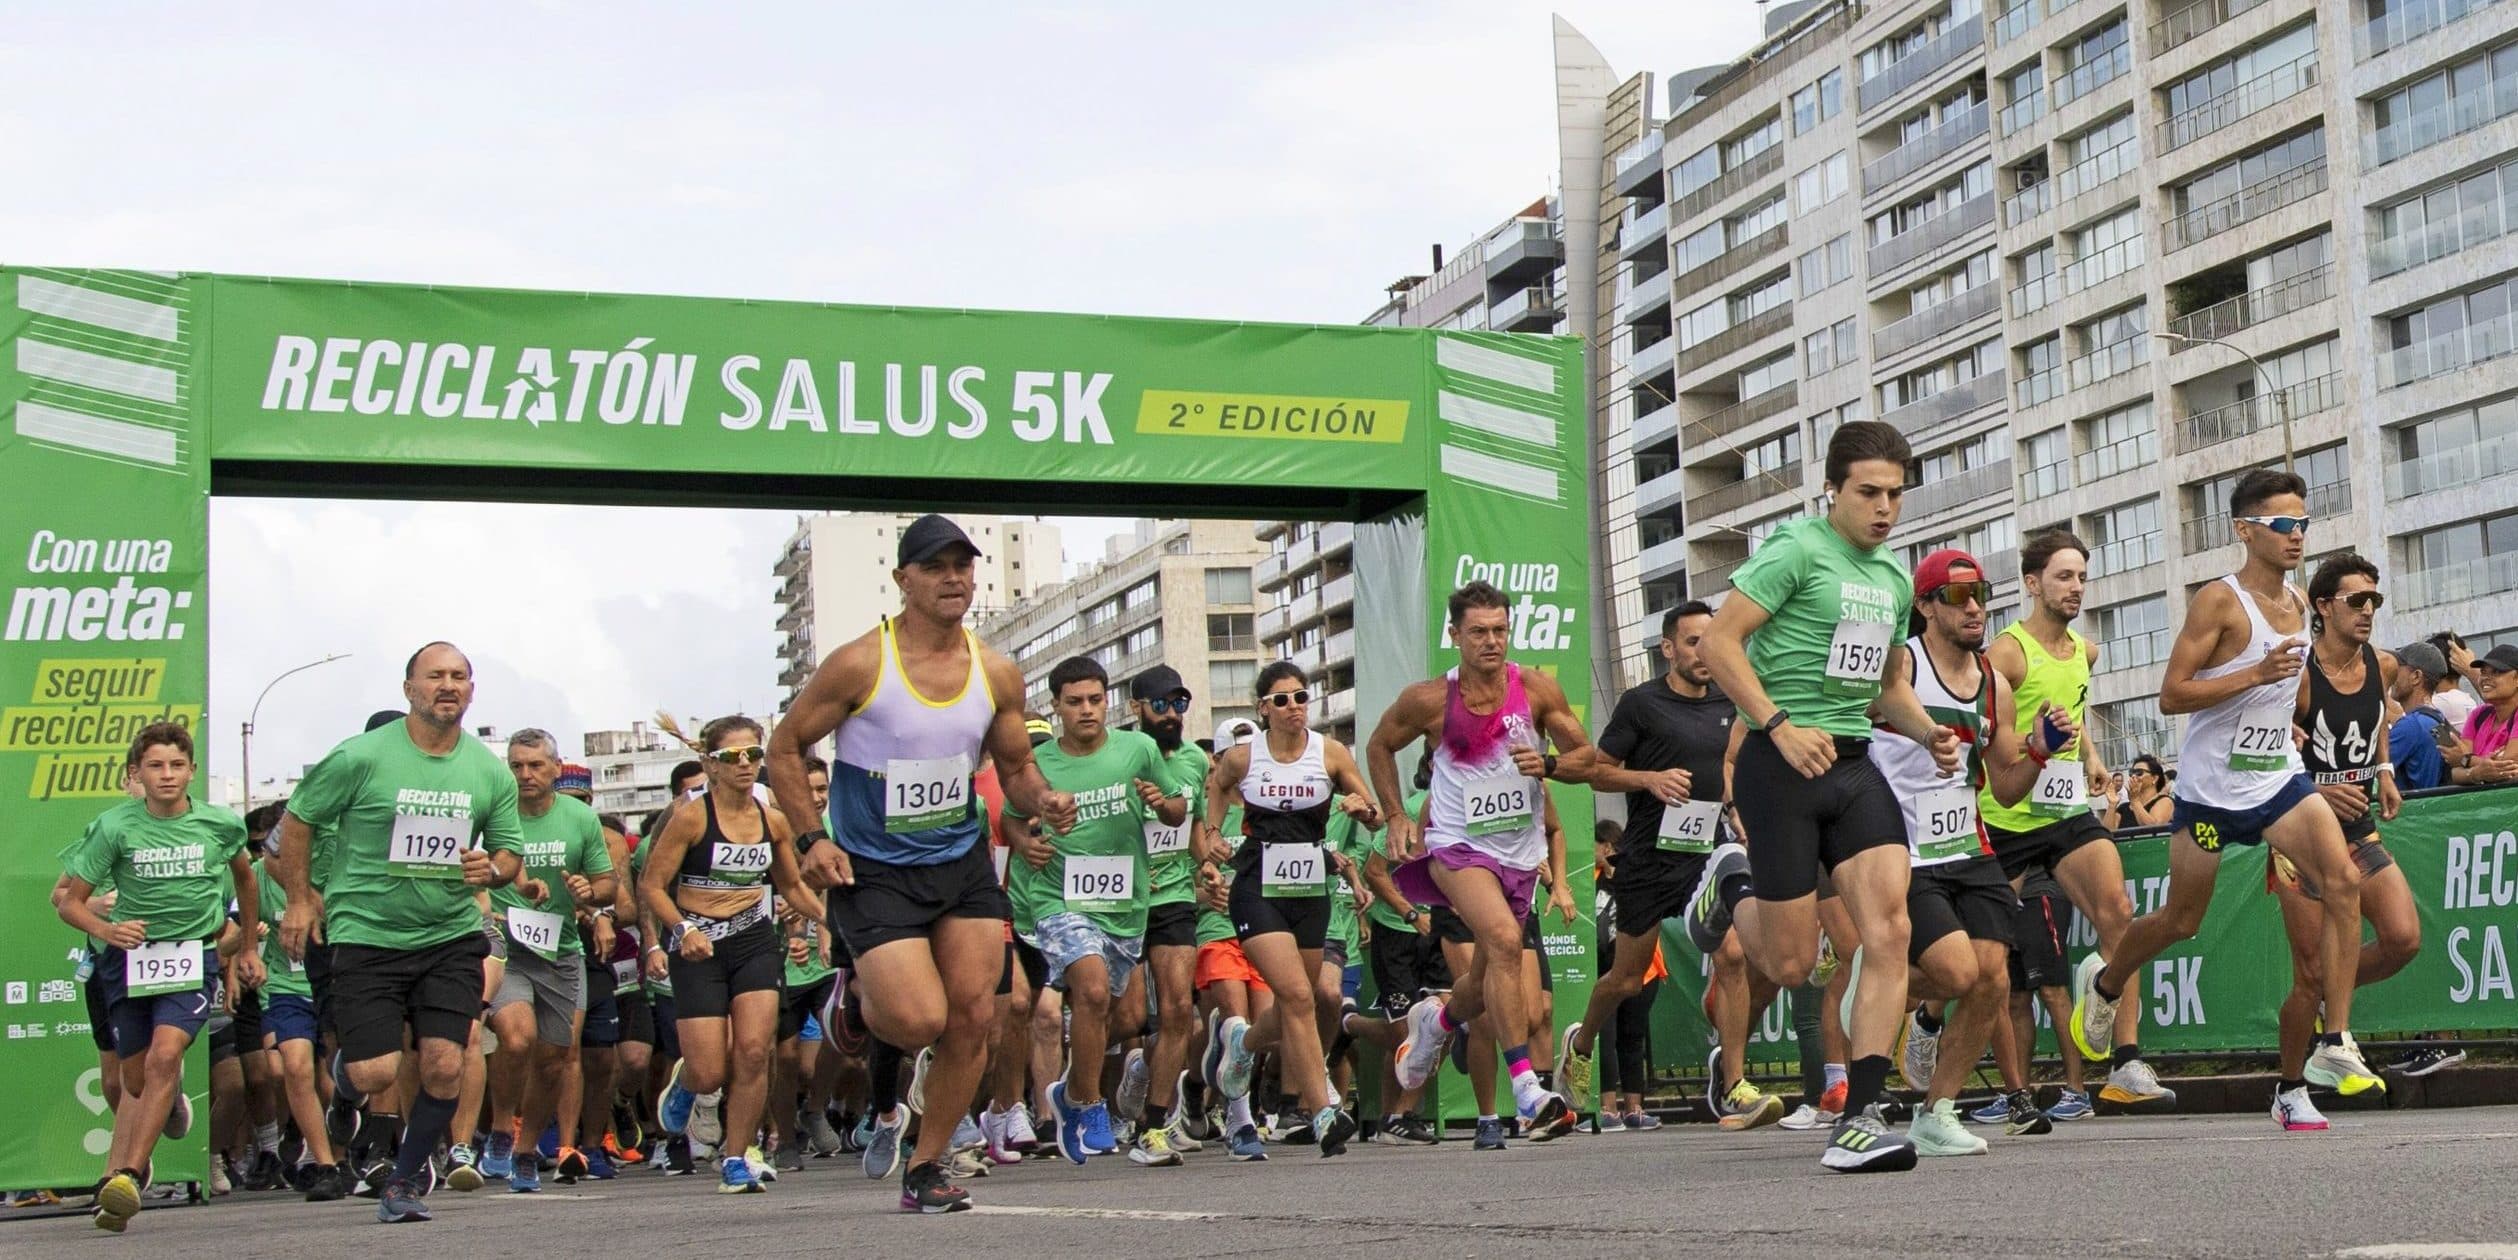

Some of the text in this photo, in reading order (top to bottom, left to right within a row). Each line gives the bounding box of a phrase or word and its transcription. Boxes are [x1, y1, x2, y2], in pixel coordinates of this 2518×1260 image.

[262, 335, 1114, 444] RECICLATÓN SALUS 5K
[1219, 402, 1376, 435] EDICIÓN
[27, 530, 173, 573] Con una
[1509, 562, 1559, 592] una
[5, 576, 193, 641] meta:
[1840, 601, 1881, 623] SALUS
[1839, 643, 1882, 673] 1593
[45, 659, 155, 705] seguir
[2239, 726, 2286, 751] 2720
[396, 788, 472, 809] RECICLATÓN
[897, 777, 960, 809] 1304
[1074, 782, 1127, 806] CICLATÓN
[1260, 785, 1314, 797] LEGION
[2044, 777, 2074, 800] 628
[1076, 804, 1109, 823] ALUS
[1111, 799, 1129, 815] 5K
[1471, 790, 1525, 817] 2603
[1679, 816, 1704, 836] 45
[1931, 806, 1968, 836] 507
[405, 834, 456, 858] 1199
[1153, 829, 1178, 849] 741
[133, 842, 206, 864] RECICLATÓN
[550, 854, 567, 866] 5K
[719, 846, 768, 867] 2496
[134, 860, 206, 878] SALUS 5K
[1275, 860, 1314, 880] 407
[2444, 831, 2518, 909] REC
[1072, 873, 1124, 894] 1098
[516, 923, 550, 945] 1961
[1542, 933, 1577, 945] DÓNDE
[1543, 945, 1585, 956] RECICLO
[136, 958, 192, 979] 1959
[2153, 957, 2206, 1026] 5K
